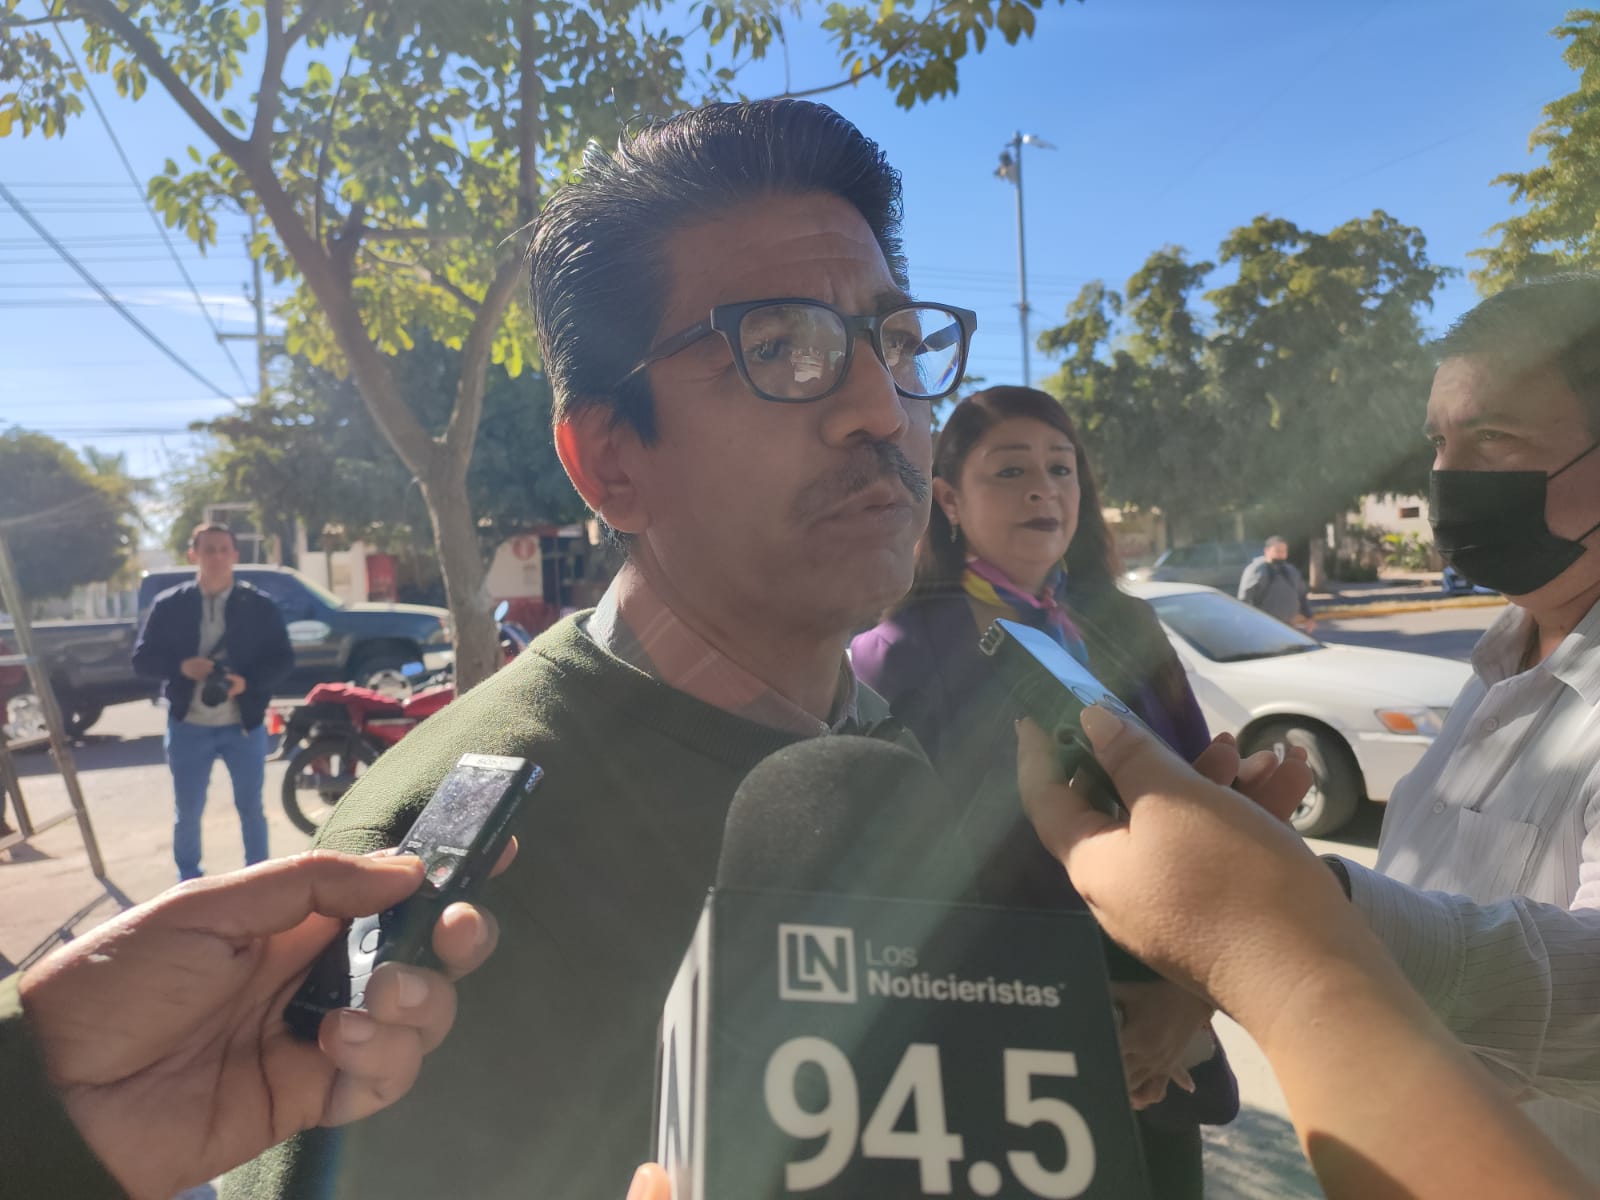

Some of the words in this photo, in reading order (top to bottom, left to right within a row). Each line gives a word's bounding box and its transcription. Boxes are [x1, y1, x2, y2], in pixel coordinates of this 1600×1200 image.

[786, 932, 850, 993] LN
[865, 939, 918, 967] Los
[867, 970, 1062, 1008] Noticieristas
[763, 1036, 1096, 1199] 94.5
